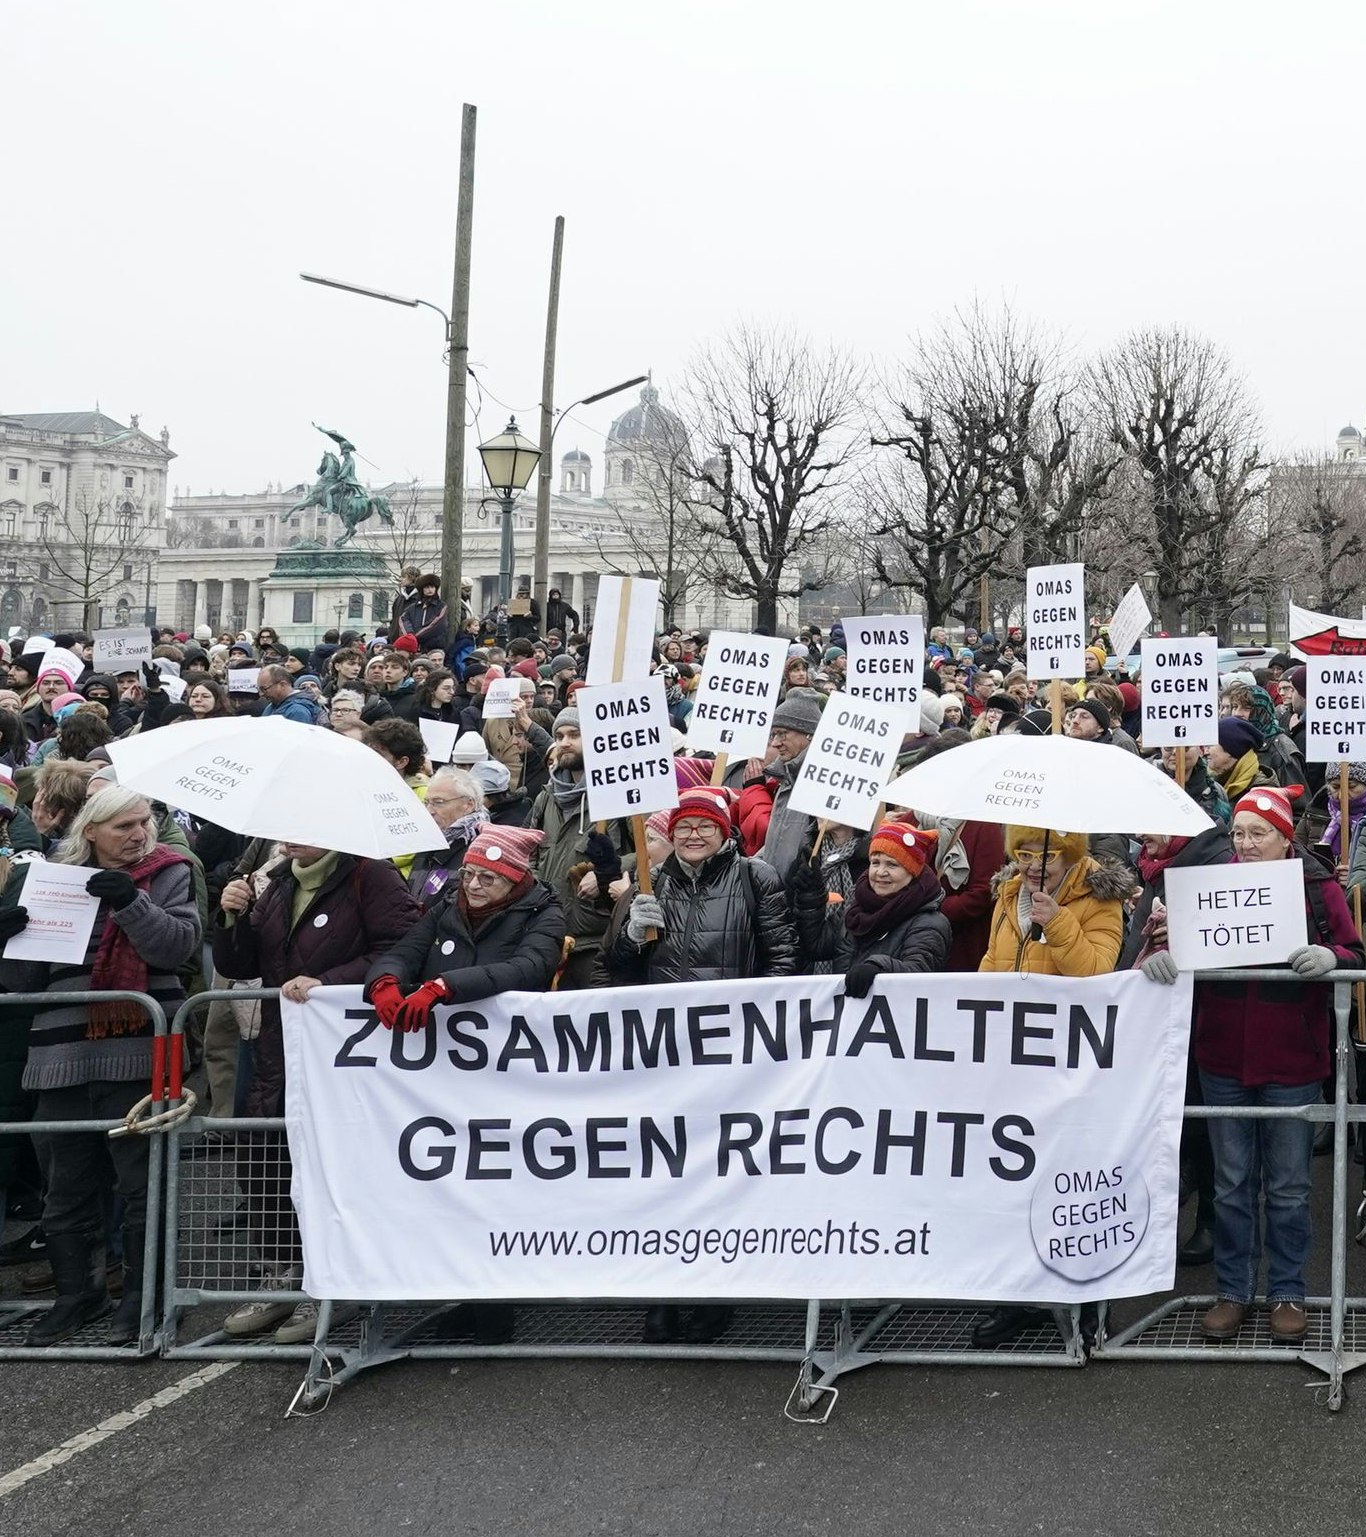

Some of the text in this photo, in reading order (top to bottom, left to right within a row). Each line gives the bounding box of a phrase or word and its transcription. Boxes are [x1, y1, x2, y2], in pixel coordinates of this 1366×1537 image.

[1037, 580, 1071, 596] OMAS
[1034, 607, 1076, 623] GEGEN
[861, 630, 908, 645] OMAS
[1031, 634, 1080, 650] RECHTS
[721, 649, 769, 668] OMAS
[857, 659, 913, 673] GEGEN
[1156, 653, 1202, 667] OMAS
[709, 676, 768, 697] GEGEN
[1151, 679, 1207, 693] GEGEN
[596, 696, 650, 720] OMAS
[1147, 704, 1212, 719] RECHTS
[1316, 696, 1364, 709] GEGE
[697, 703, 767, 726] RECHTS
[839, 712, 888, 736] OMAS
[594, 727, 659, 753] GEGEN
[822, 738, 884, 766] GEGEN
[212, 756, 252, 775] OMAS
[592, 758, 669, 786] RECHTS
[1004, 771, 1044, 780] OMAS
[195, 767, 240, 787] GEGEN
[805, 765, 878, 796] RECHTS
[176, 776, 227, 800] RECHTS
[374, 793, 398, 803] OMAS
[995, 782, 1043, 794] GEGEN
[985, 794, 1040, 809] RECHTS
[382, 808, 409, 818] GEGEN
[388, 822, 418, 835] RECHTS
[1199, 888, 1271, 909] HETZE
[1199, 924, 1274, 946] TÖTET
[334, 995, 1118, 1072] ZUSAMMENHALTEN
[399, 1107, 1035, 1181] GEGEN RECHTS
[1055, 1166, 1122, 1194] OMAS
[1053, 1193, 1126, 1226] GEGEN
[490, 1220, 930, 1263] www.omasgegenrechts.at
[1050, 1222, 1136, 1260] RECHTS
